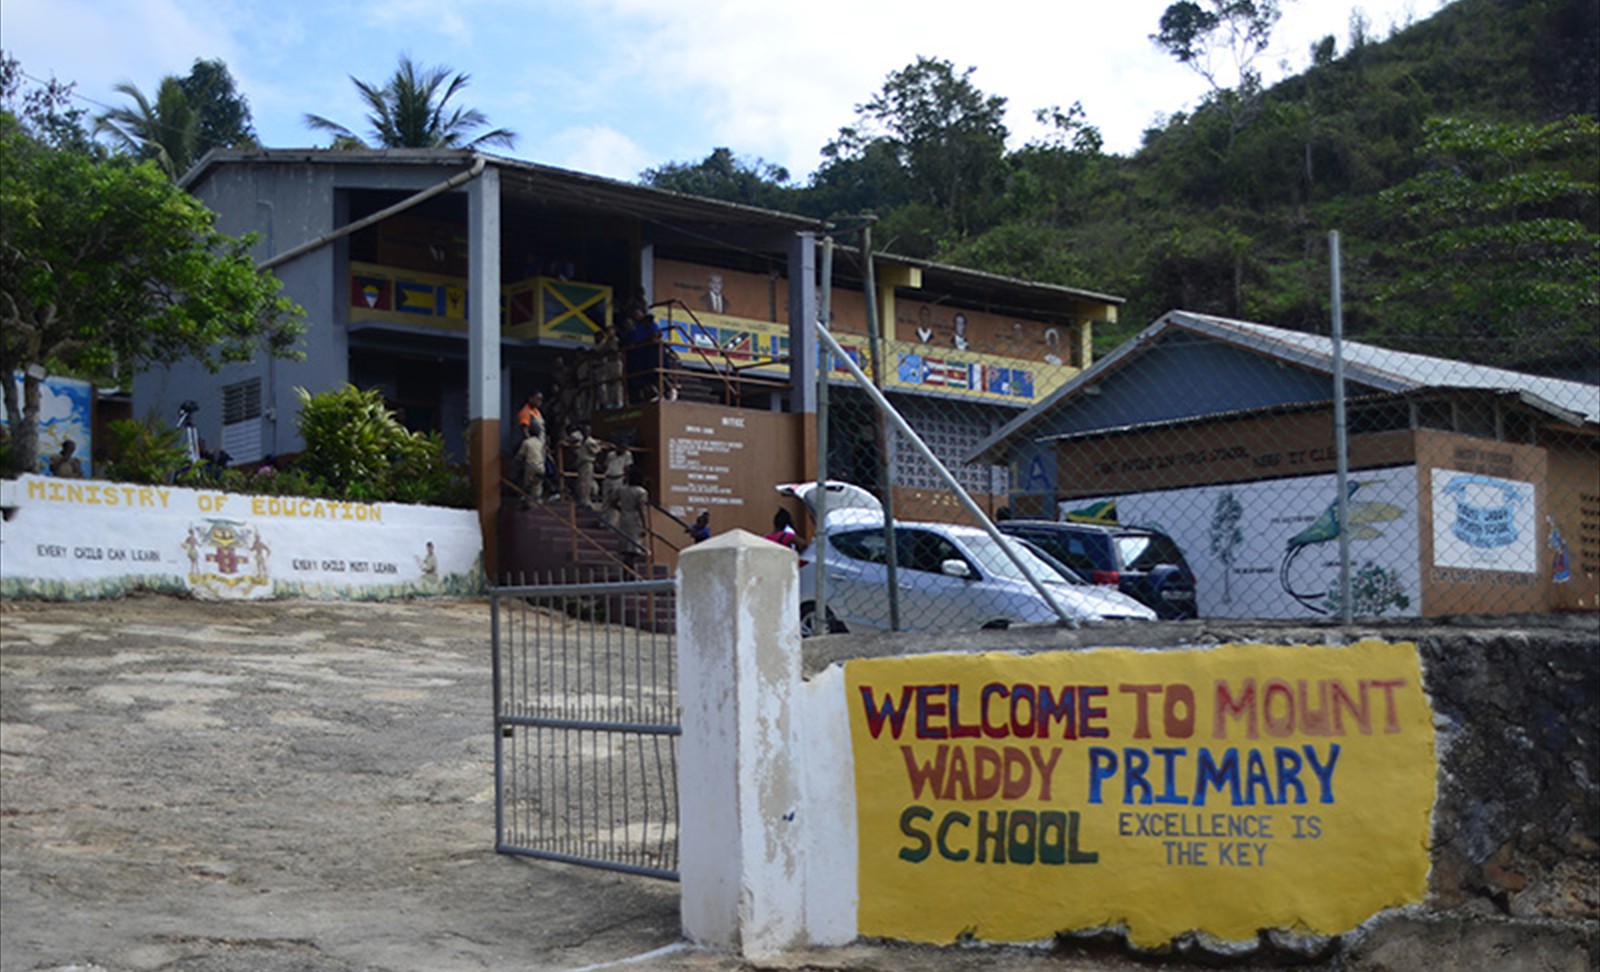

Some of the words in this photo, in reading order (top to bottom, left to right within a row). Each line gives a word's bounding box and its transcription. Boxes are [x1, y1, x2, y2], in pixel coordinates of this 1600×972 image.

[27, 479, 172, 508] MINISTRY
[197, 494, 229, 512] OF
[251, 497, 382, 521] EDUCATION
[37, 544, 68, 558] EVERY
[74, 547, 104, 561] CHILD
[107, 548, 127, 561] CAN
[131, 550, 162, 562] LEARN
[292, 558, 319, 571] EVERY
[373, 563, 399, 574] LEARN
[859, 682, 1110, 740] WELCOME
[1119, 682, 1196, 739] TO
[1211, 676, 1408, 741] MOUNT
[900, 744, 1063, 802] WADDY
[1086, 742, 1342, 807] PRIMARY
[898, 805, 1099, 865] SCHOOL
[1118, 812, 1274, 840] EXCELLENCE
[1291, 814, 1322, 840] IS
[1163, 840, 1208, 866] THE
[1217, 841, 1268, 867] KEY
